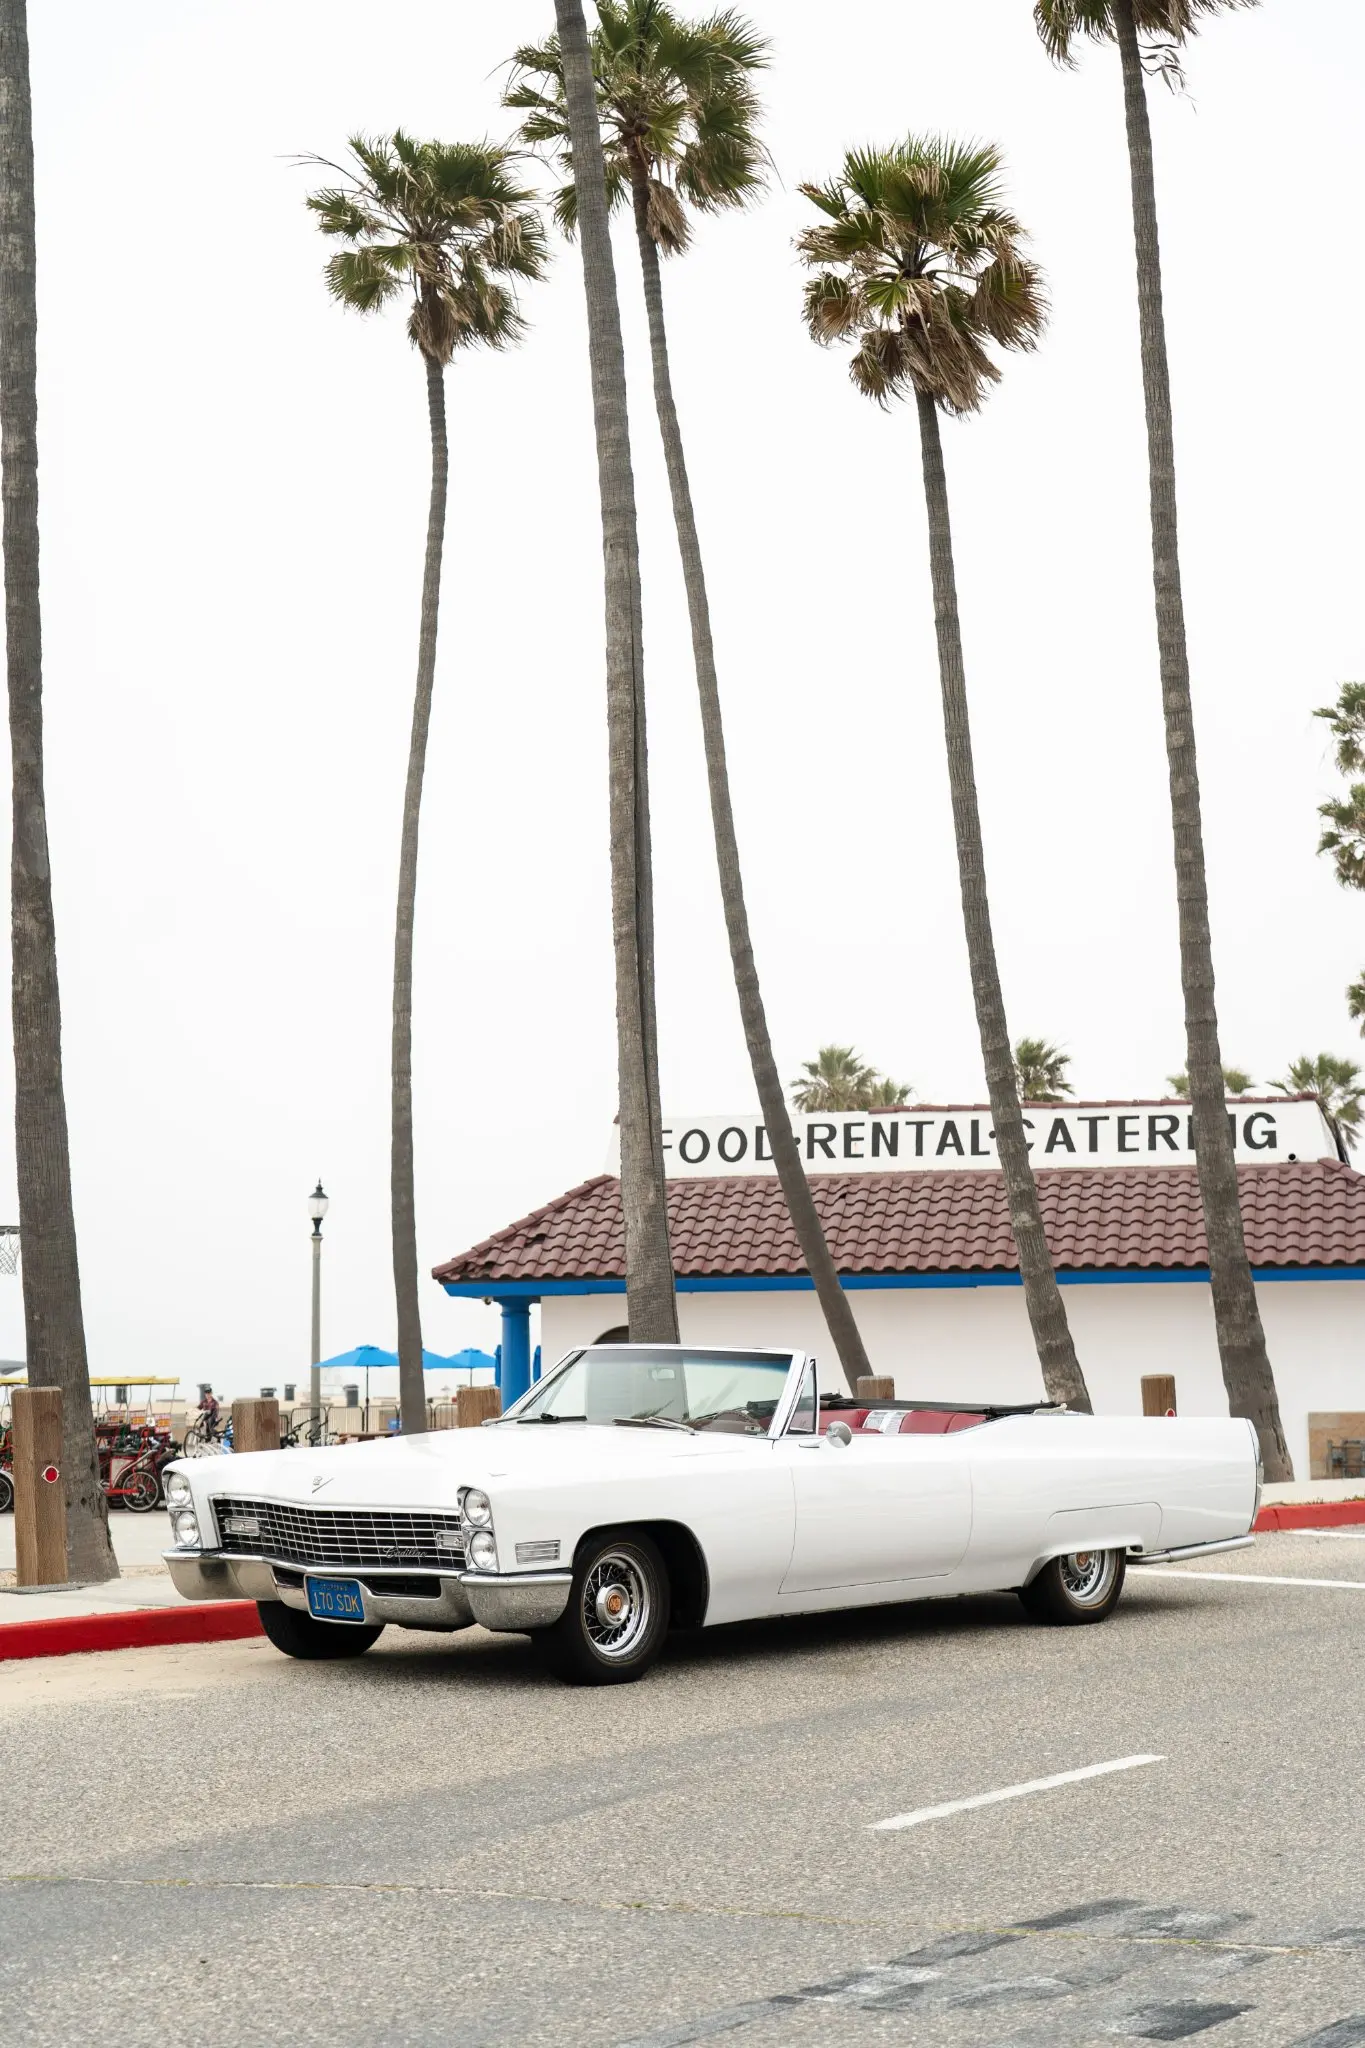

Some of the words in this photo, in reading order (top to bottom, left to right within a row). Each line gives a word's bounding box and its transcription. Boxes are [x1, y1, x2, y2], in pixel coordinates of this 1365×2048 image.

[807, 1119, 990, 1159] RENTAL
[1021, 1112, 1277, 1153] ATERIG
[313, 1591, 333, 1610] 170
[336, 1593, 360, 1612] SDK
